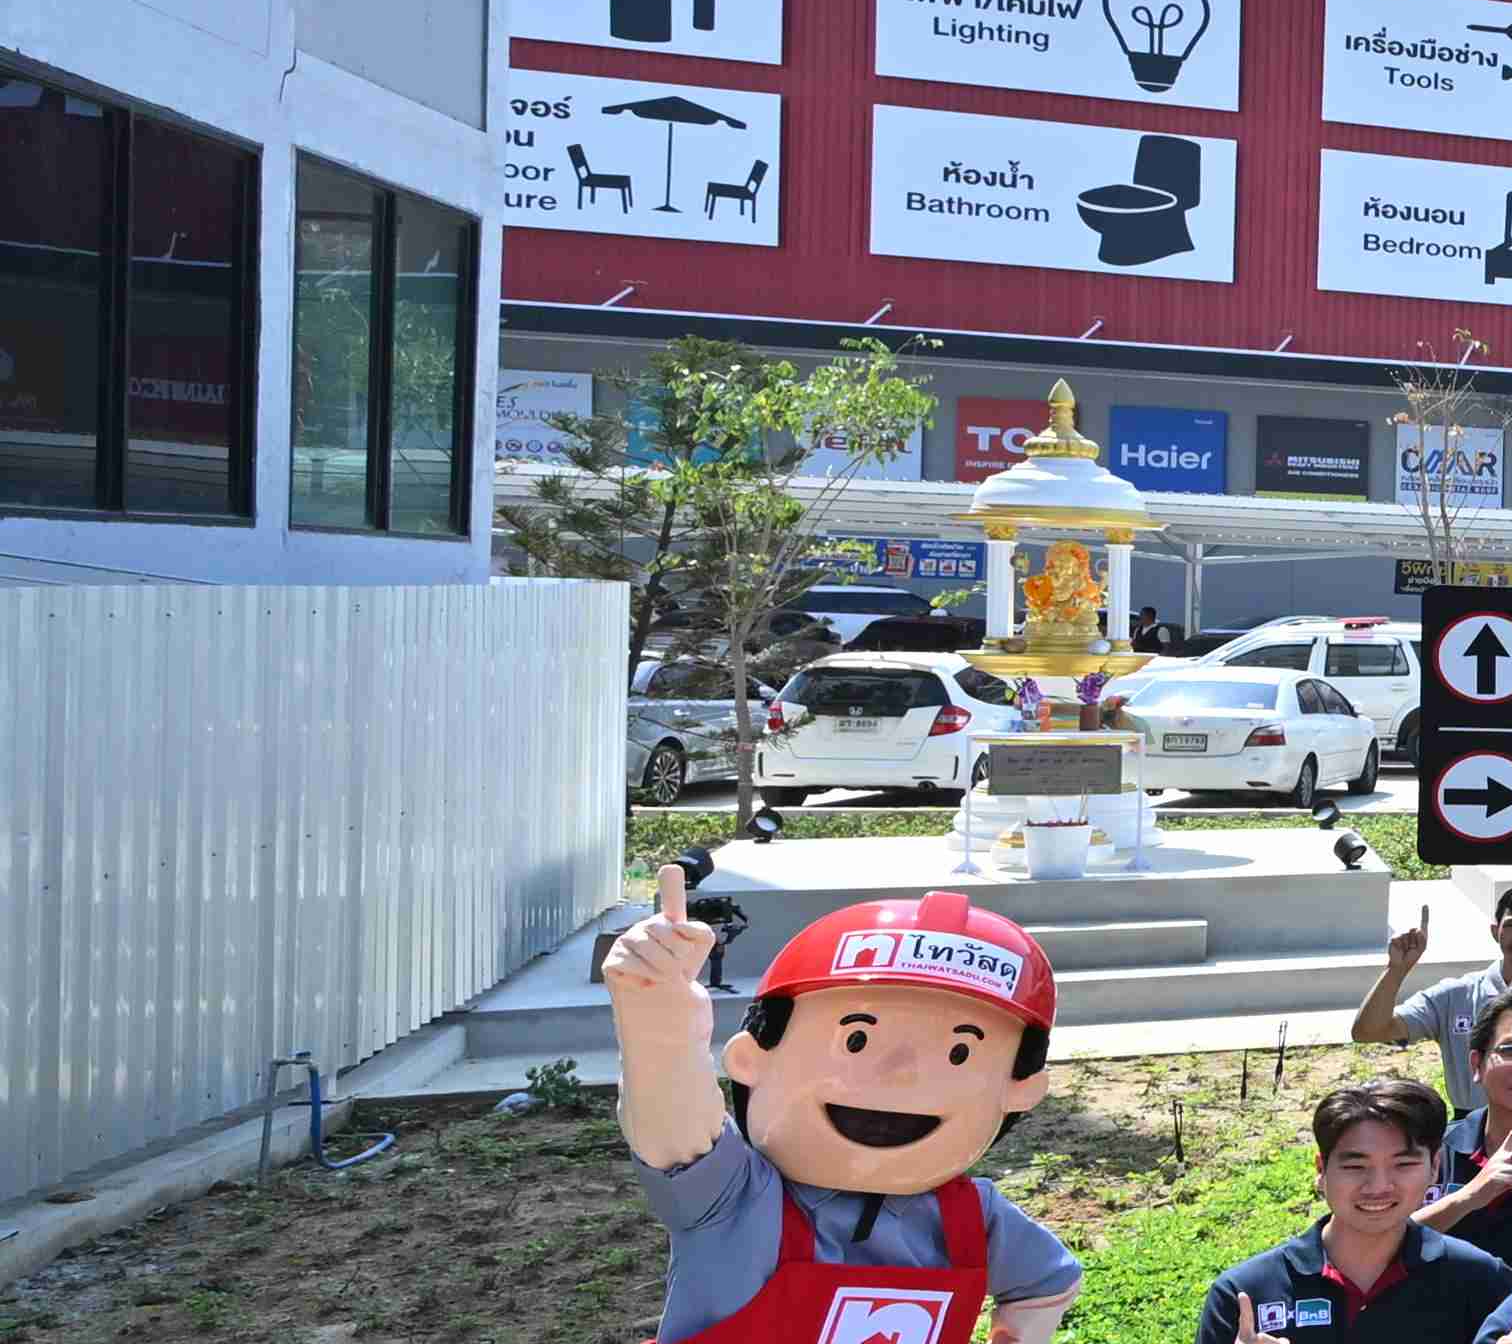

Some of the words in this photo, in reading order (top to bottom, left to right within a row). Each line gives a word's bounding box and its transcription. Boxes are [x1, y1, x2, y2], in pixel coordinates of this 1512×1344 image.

[932, 16, 1051, 52] Lighting
[1345, 31, 1499, 68] เครื่องมือช่าง
[1384, 67, 1455, 92] Tools
[942, 160, 1035, 191] ห้องน้ำ
[905, 192, 1051, 224] Bathroom
[1362, 196, 1466, 226] ห้องนอน
[1362, 233, 1483, 260] Bedroom
[1120, 442, 1211, 470] Haier
[901, 962, 1002, 988] THAIWATSADU.COM
[910, 933, 1017, 991] ไทวัสดุ
